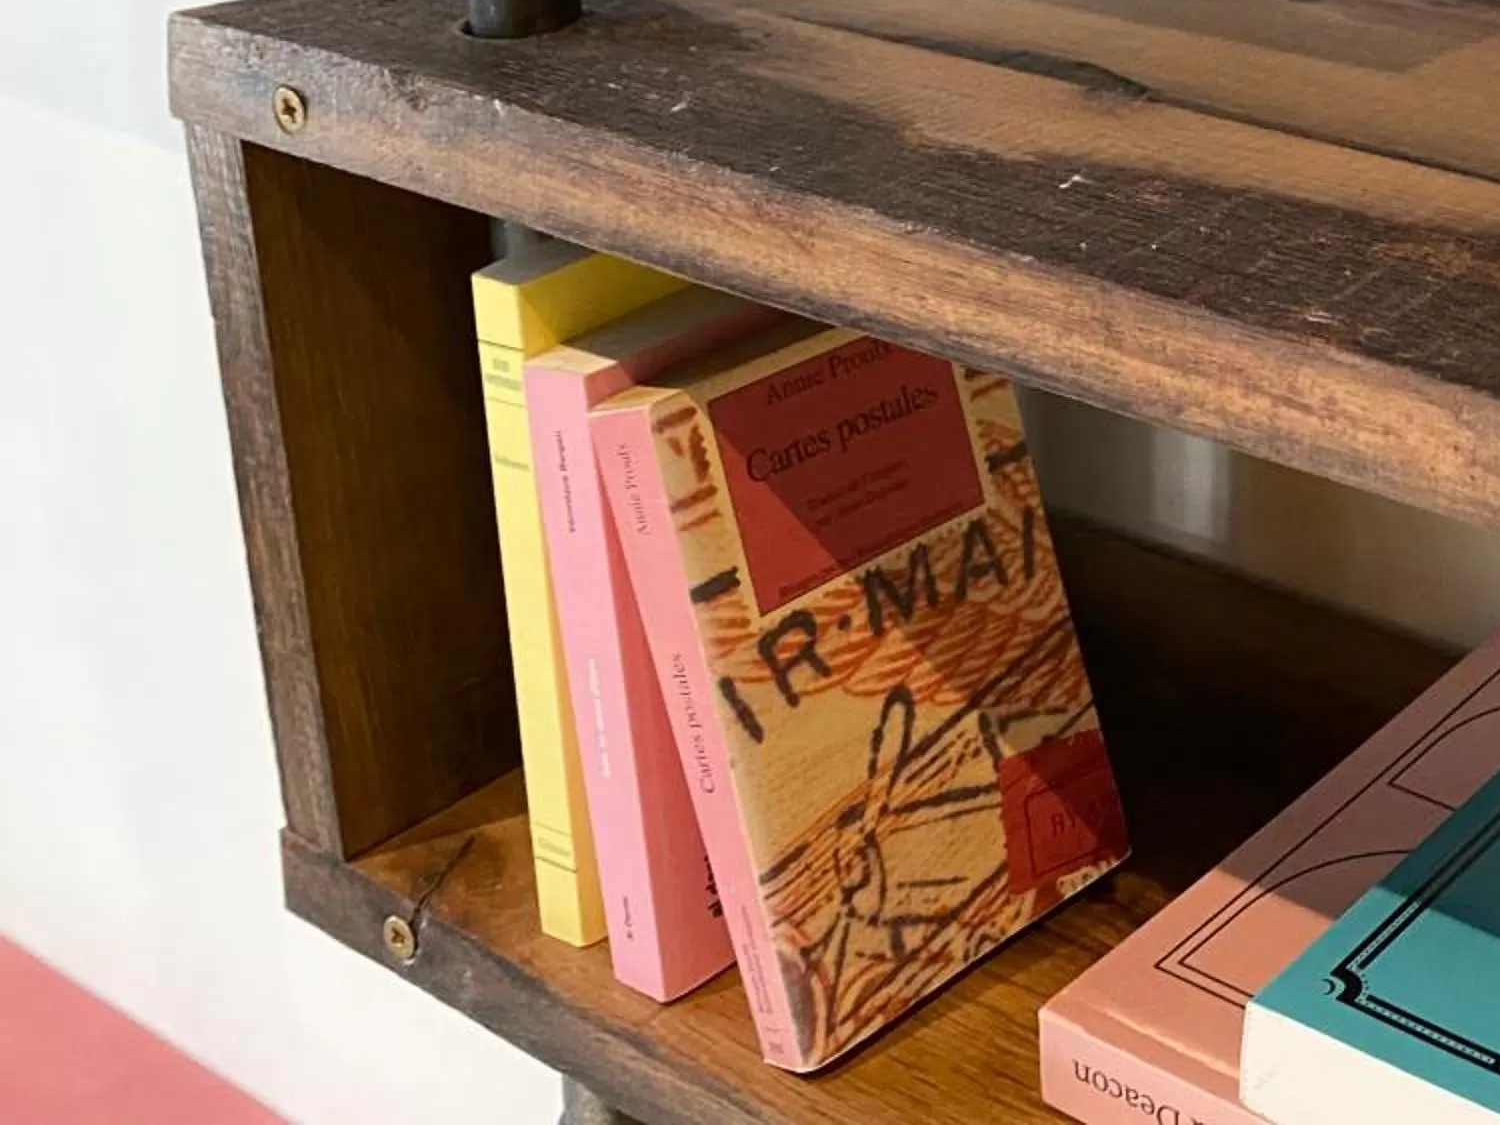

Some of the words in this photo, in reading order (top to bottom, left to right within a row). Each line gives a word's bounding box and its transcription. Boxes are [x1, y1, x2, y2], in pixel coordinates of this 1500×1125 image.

[766, 368, 826, 407] Annie
[745, 425, 833, 483] Cartes
[836, 381, 940, 454] postales
[694, 732, 716, 795] Cartes
[1071, 1058, 1182, 1125] Deacon
